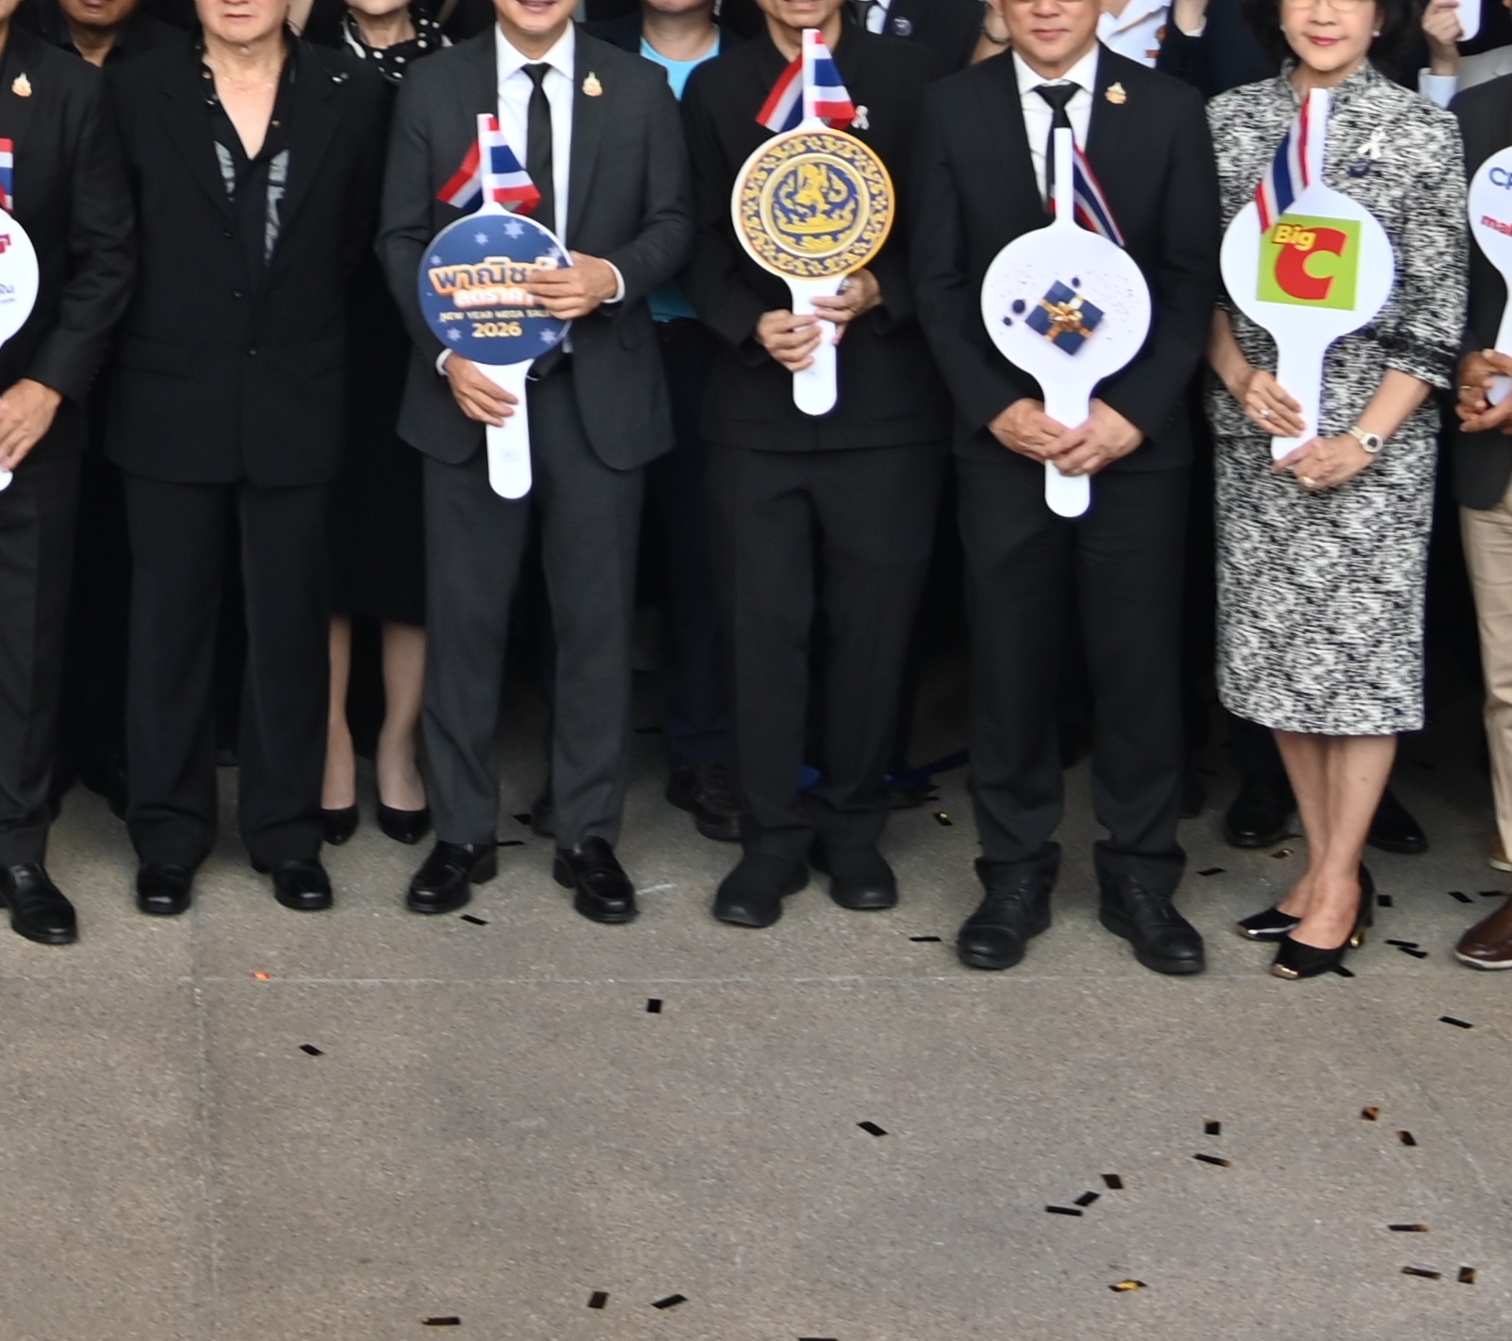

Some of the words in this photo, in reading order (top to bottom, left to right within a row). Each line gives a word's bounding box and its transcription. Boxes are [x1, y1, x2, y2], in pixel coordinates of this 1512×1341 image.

[1273, 223, 1317, 251] Big
[1274, 226, 1348, 301] C
[465, 309, 491, 322] YEAR
[493, 309, 523, 322] MEGA
[471, 320, 523, 340] 2026
